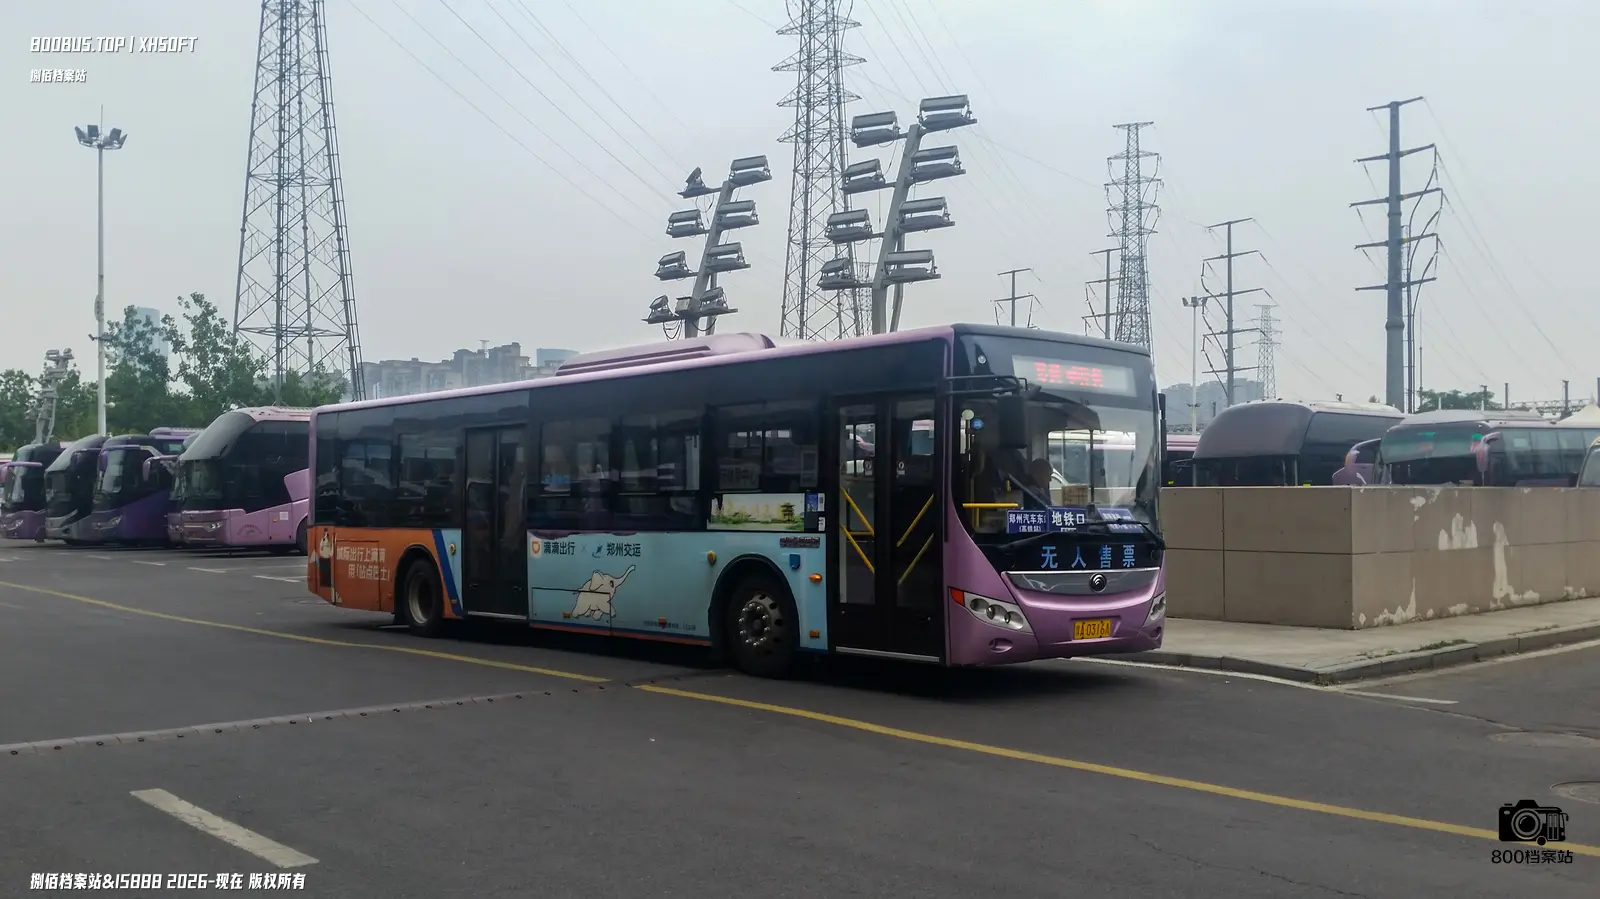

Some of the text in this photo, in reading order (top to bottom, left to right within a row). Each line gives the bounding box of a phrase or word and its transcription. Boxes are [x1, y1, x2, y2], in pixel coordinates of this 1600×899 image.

[1051, 511, 1085, 526] 地铁口
[543, 541, 576, 557] 滴滴出行
[606, 542, 642, 558] 郑州交运
[1040, 544, 1136, 569] 无人售票
